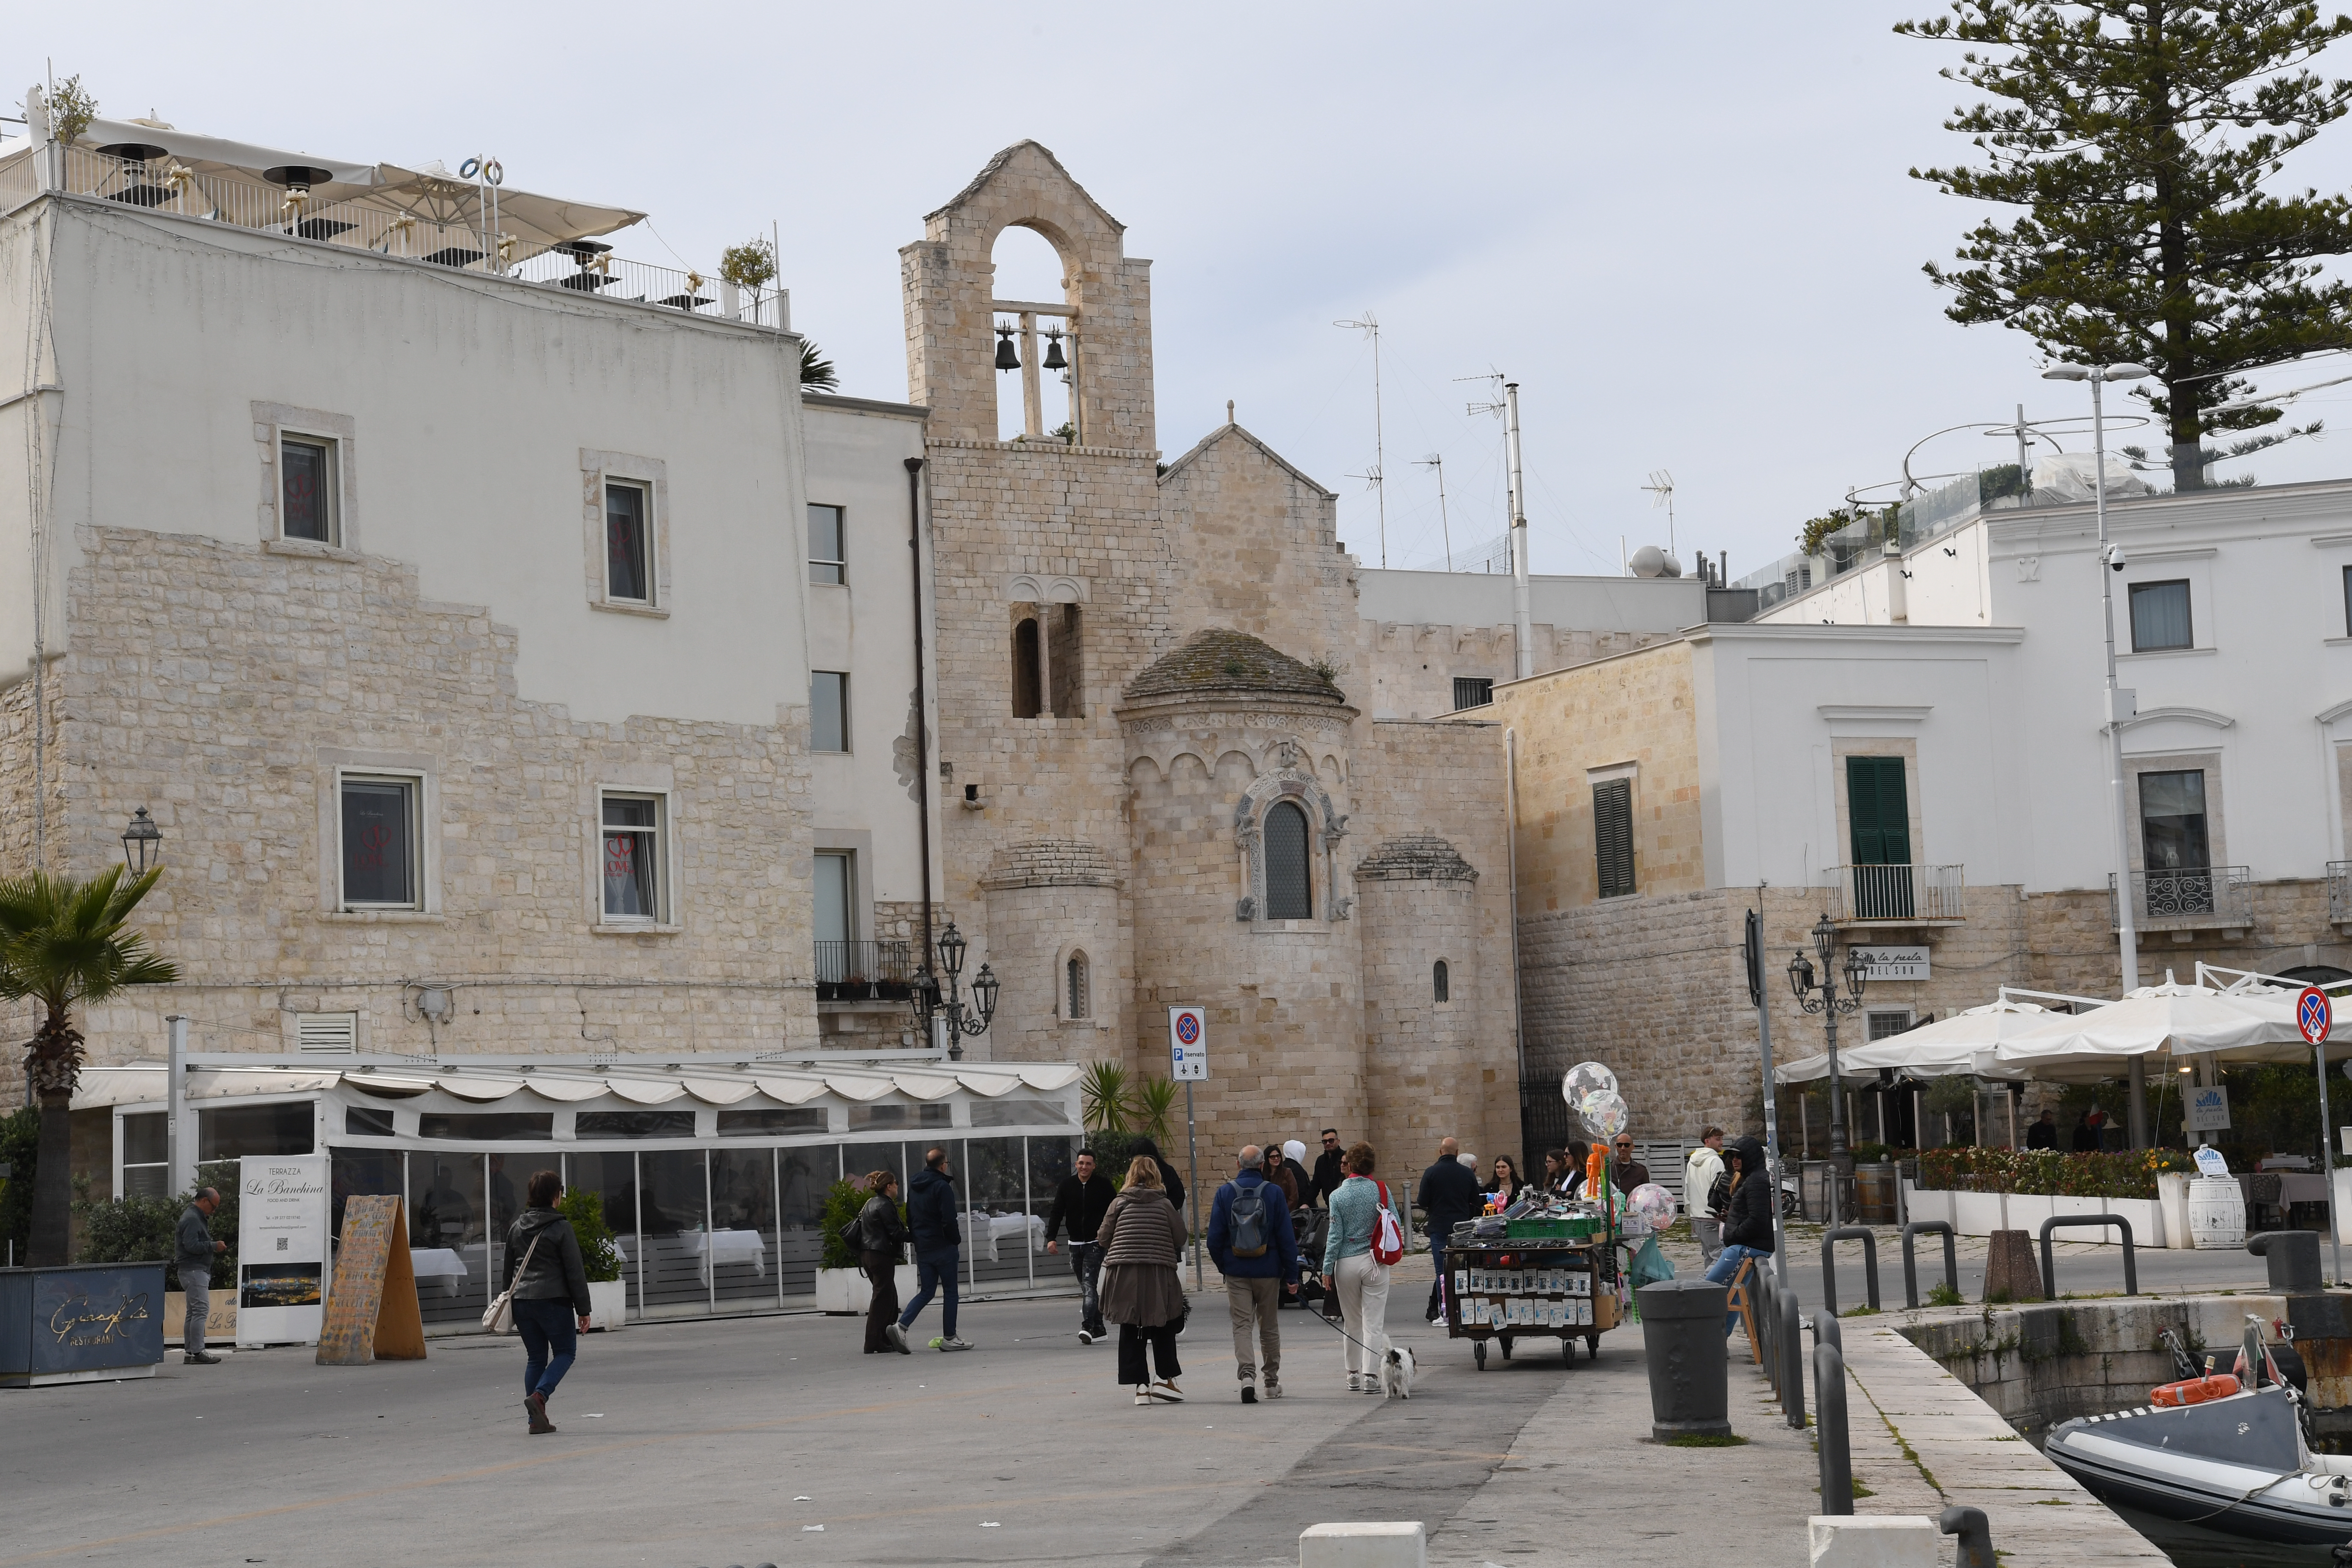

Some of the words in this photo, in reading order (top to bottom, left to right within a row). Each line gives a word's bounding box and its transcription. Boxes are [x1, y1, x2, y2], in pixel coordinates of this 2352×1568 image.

[1878, 952, 1890, 961] la
[1889, 952, 1922, 966] perla
[1871, 966, 1888, 975] DEL
[1895, 966, 1914, 975] SUD
[1175, 1049, 1181, 1059] P
[2202, 1106, 2224, 1116] perla
[245, 1179, 264, 1195] La
[267, 1179, 324, 1195] Banchina
[207, 1312, 223, 1329] La
[70, 1334, 115, 1346] RESTAURANT
